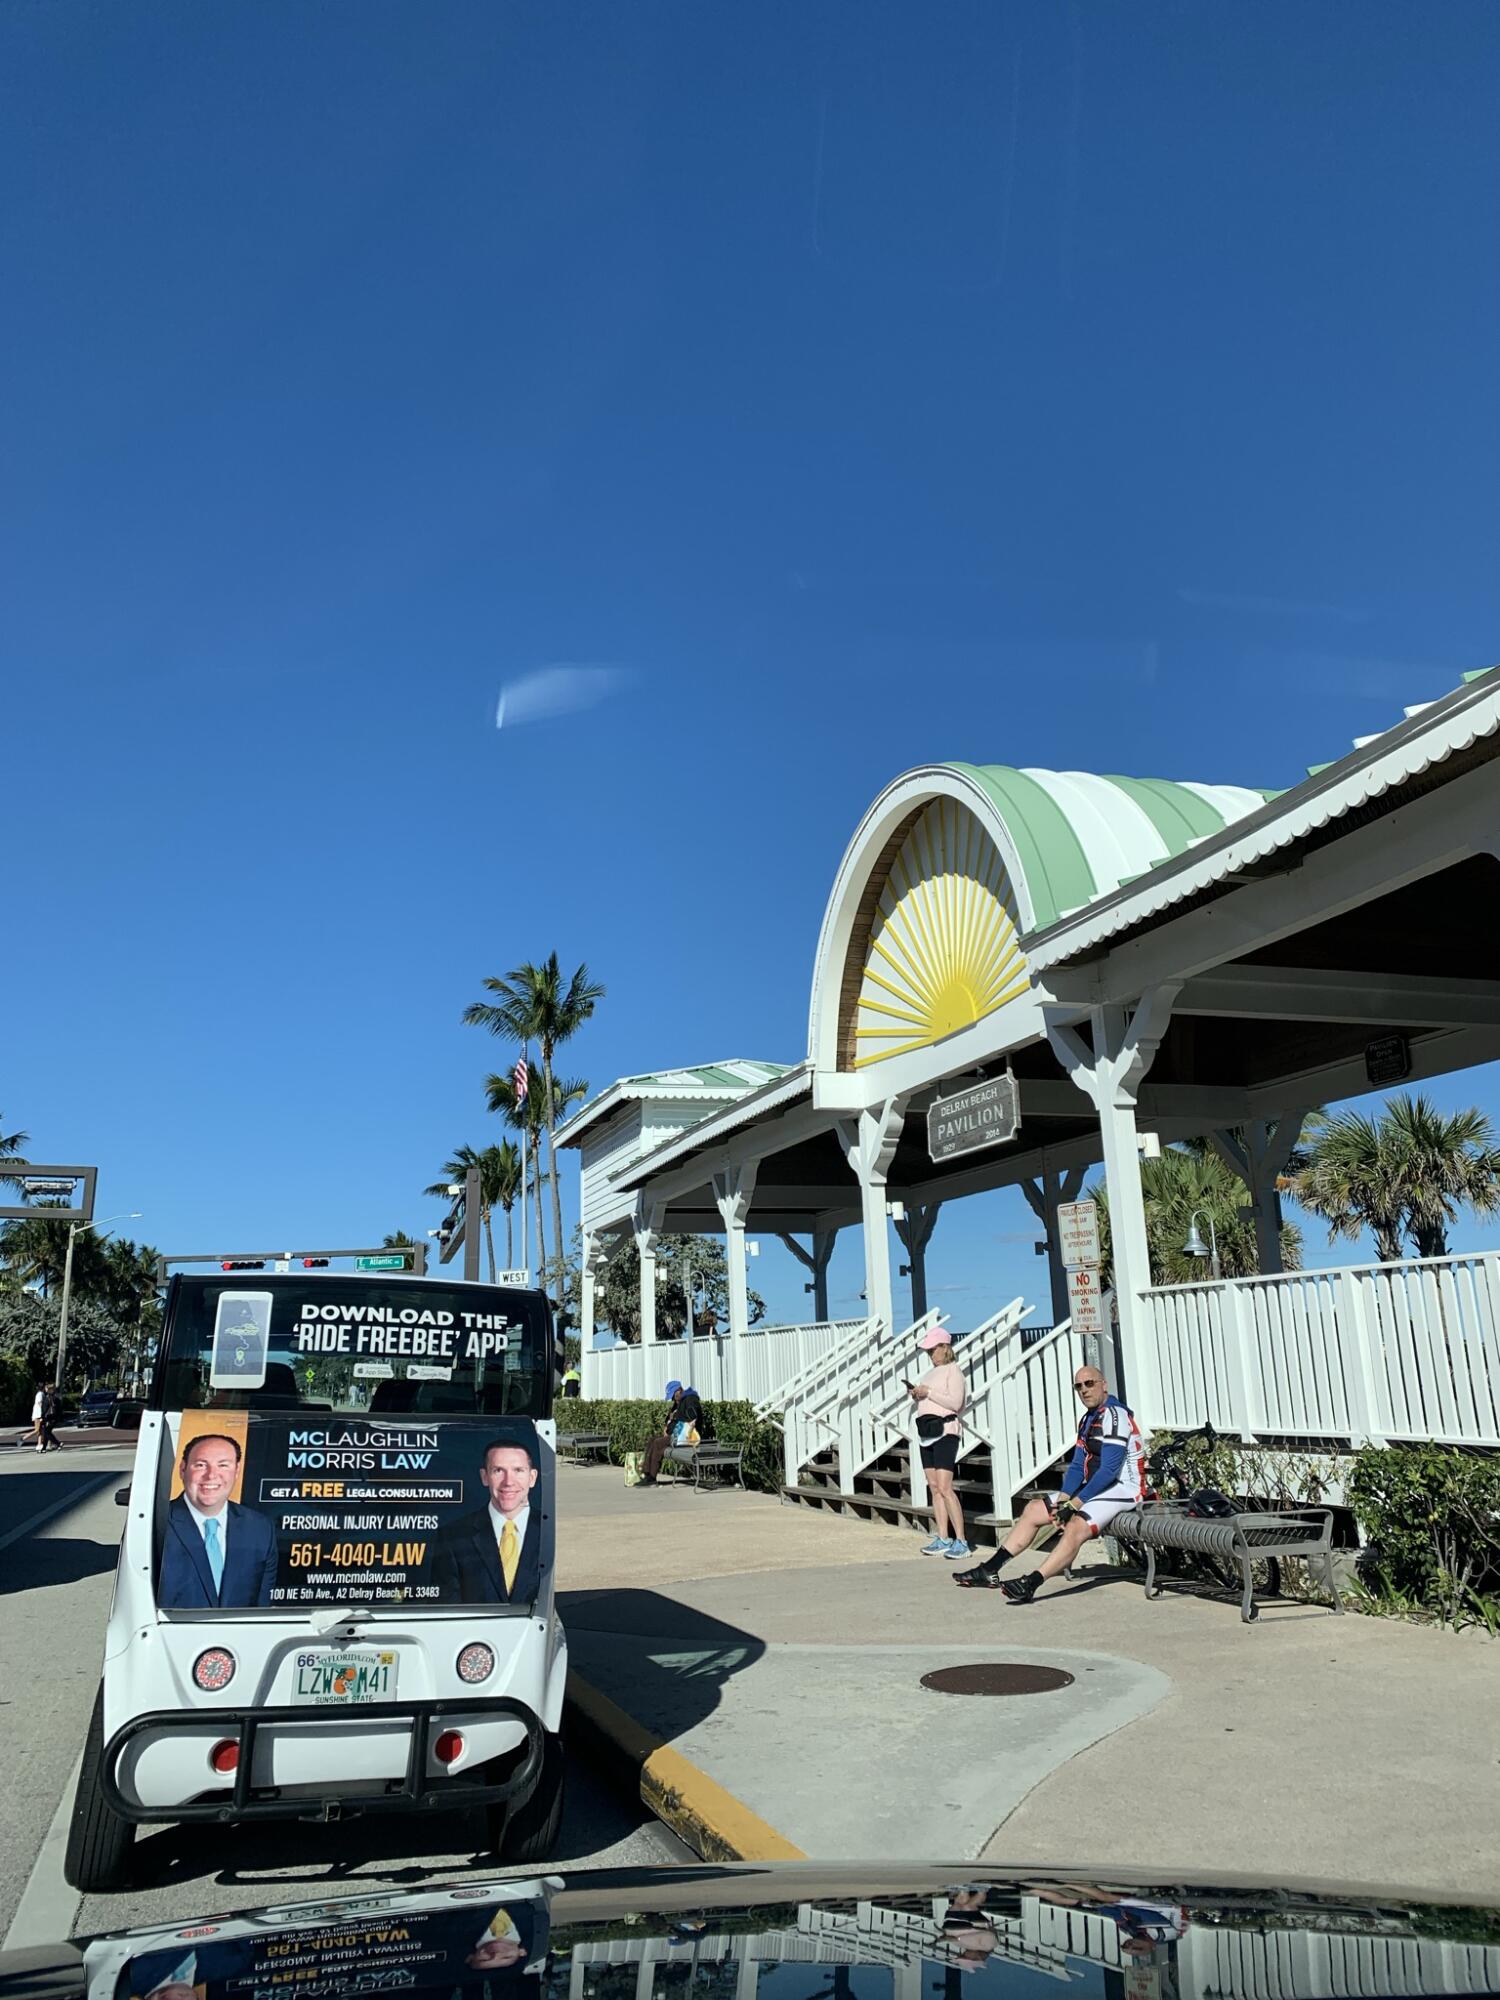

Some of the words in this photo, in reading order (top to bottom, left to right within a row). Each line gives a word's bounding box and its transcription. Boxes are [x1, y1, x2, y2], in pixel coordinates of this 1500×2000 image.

[941, 1099, 969, 1117] DELRAY
[970, 1087, 998, 1106] BEACH
[937, 1104, 1004, 1140] PAVILION
[369, 1257, 393, 1265] Atlantic
[502, 1272, 526, 1282] WEST
[1076, 1274, 1090, 1286] NO
[1071, 1288, 1098, 1296] SMOKING
[301, 1304, 454, 1326] DOWNLOAD
[460, 1312, 508, 1330] THE
[1076, 1307, 1096, 1315] VAPING
[465, 1331, 508, 1358] APP
[289, 1431, 438, 1448] MCLAUGHLIN
[287, 1452, 376, 1469] MORRIS
[381, 1453, 433, 1470] LAW
[270, 1488, 291, 1498] GET
[291, 1488, 300, 1498] A
[301, 1482, 345, 1498] FREE
[346, 1488, 378, 1498] LEGAL
[378, 1488, 453, 1498] CONSULTATION
[281, 1515, 341, 1530] PERSONAL
[343, 1515, 385, 1530] INJURY
[386, 1515, 439, 1530] LAWYERS
[289, 1542, 426, 1567] 561-4040-LAW
[306, 1570, 407, 1584] www.mcmolaw.com
[269, 1588, 286, 1600] 100
[286, 1588, 299, 1600] NE
[300, 1588, 314, 1599] 5th
[315, 1588, 334, 1600] Ave.,
[336, 1587, 347, 1599] A2
[349, 1587, 374, 1601] Delray
[376, 1587, 401, 1600] Beach,
[403, 1587, 414, 1598] FL
[415, 1586, 440, 1598] 33483
[297, 1654, 315, 1667] 66
[298, 1667, 334, 1695] LZW
[357, 1666, 388, 1693] M41
[315, 1696, 348, 1704] SUNSHINE
[351, 1694, 373, 1703] STATE
